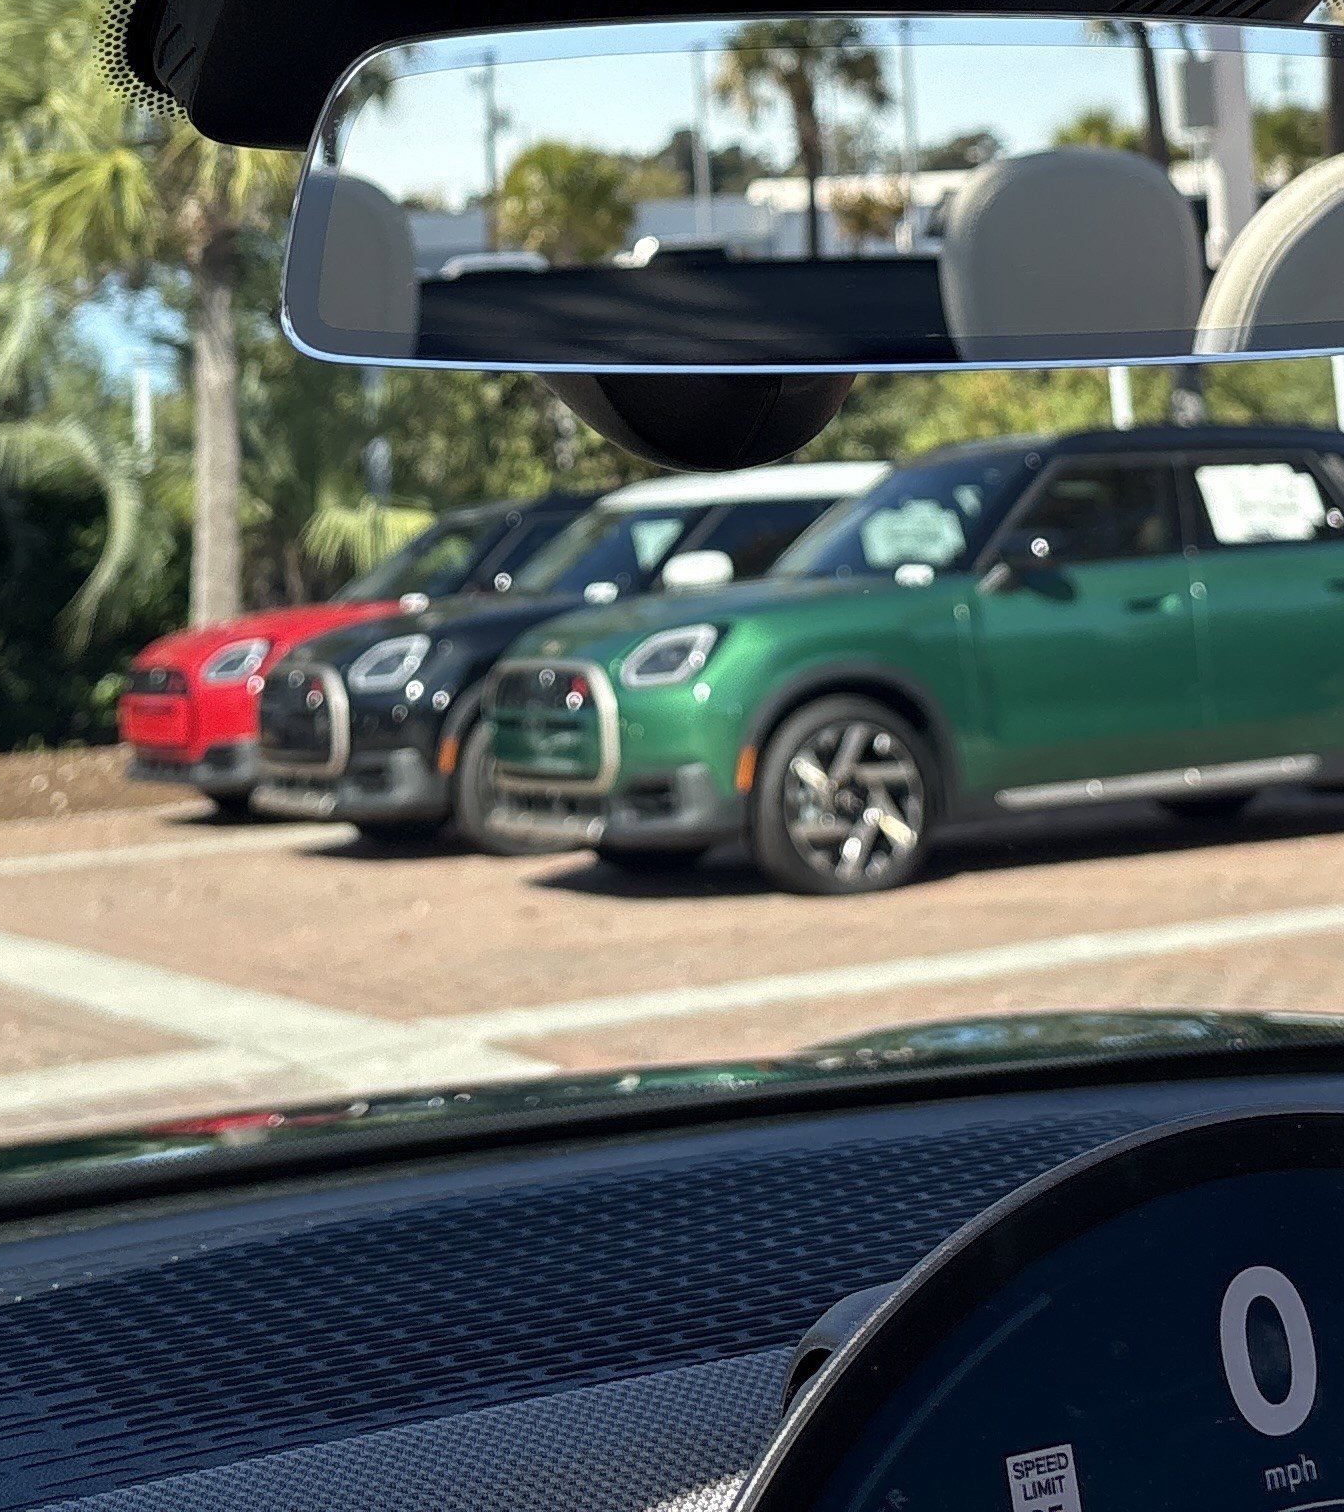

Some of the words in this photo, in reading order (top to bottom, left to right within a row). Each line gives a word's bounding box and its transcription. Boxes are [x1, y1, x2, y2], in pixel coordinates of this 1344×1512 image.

[1220, 1265, 1317, 1437] 0
[1012, 1452, 1069, 1481] SPEED
[1264, 1454, 1317, 1492] mph
[1022, 1475, 1066, 1501] LIMIT
